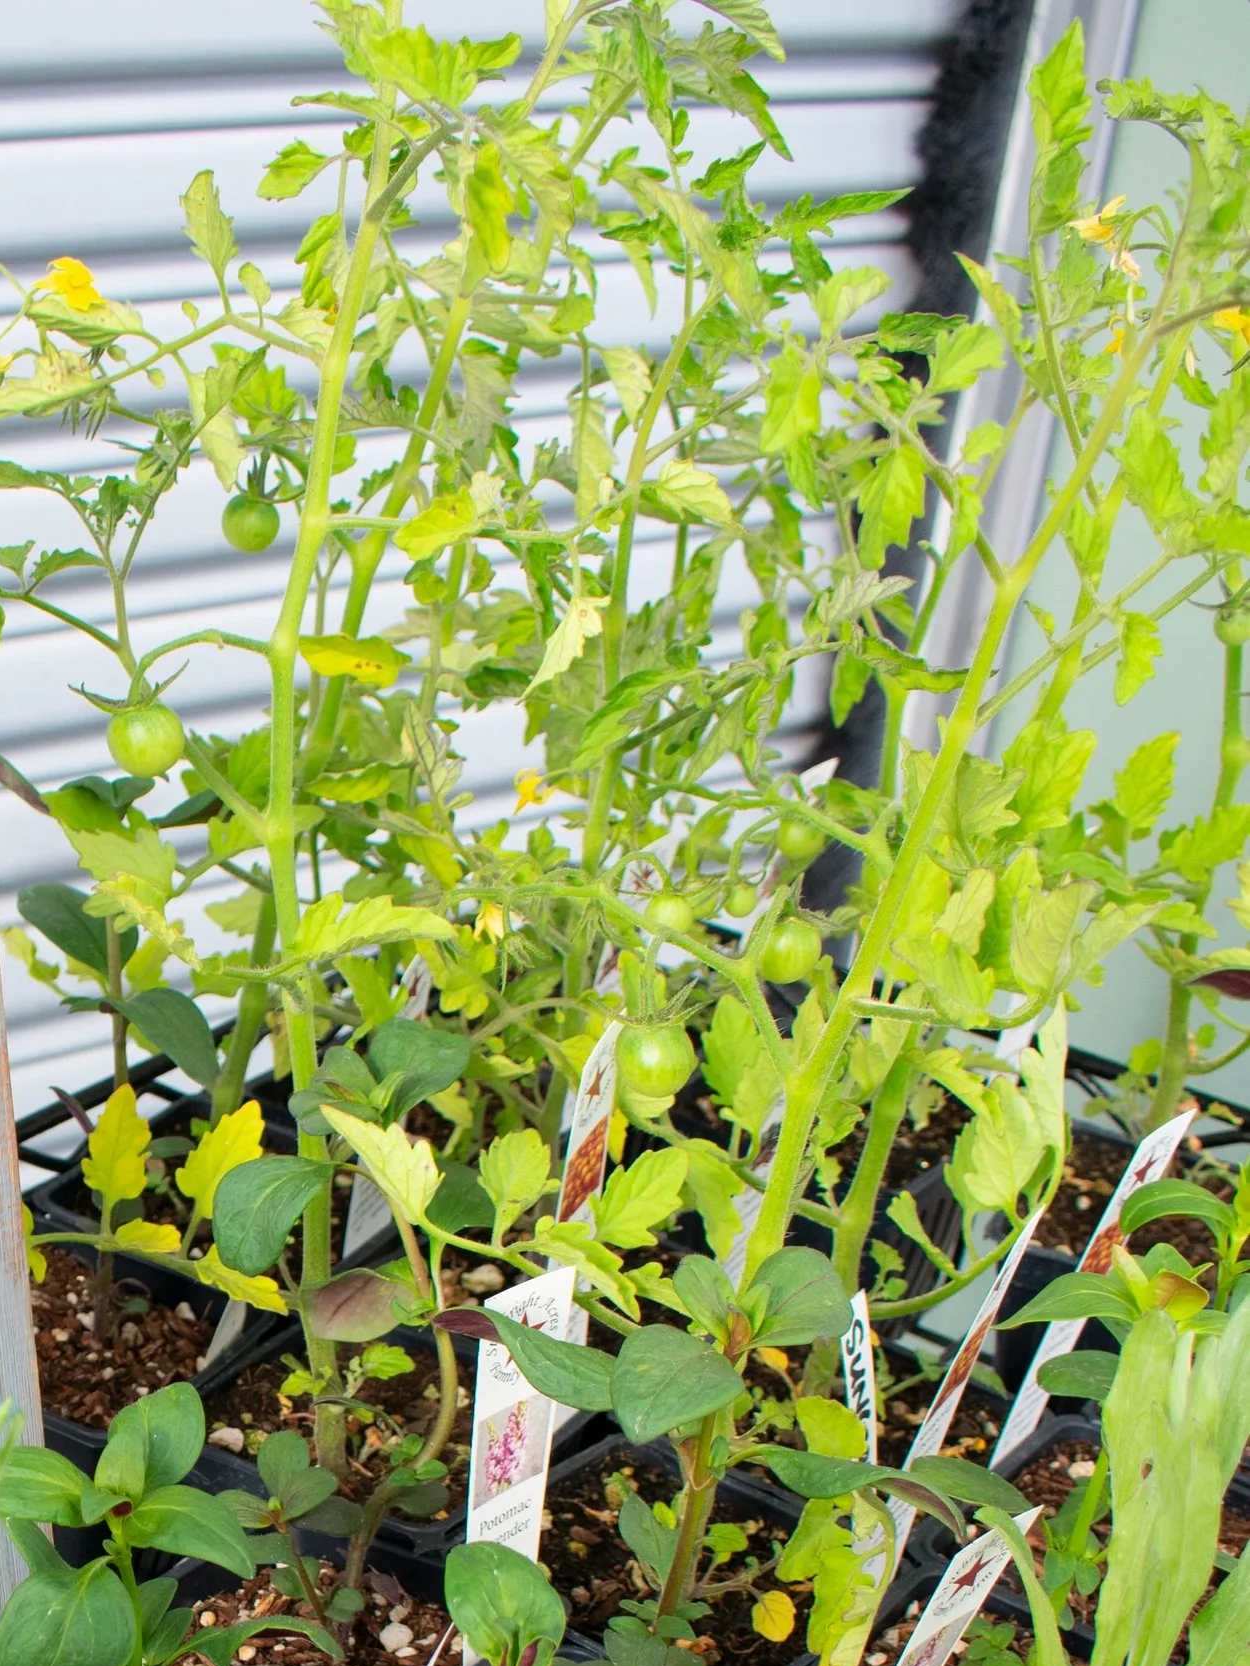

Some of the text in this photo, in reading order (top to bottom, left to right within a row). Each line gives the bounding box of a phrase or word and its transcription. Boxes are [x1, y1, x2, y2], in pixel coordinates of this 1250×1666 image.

[538, 1297, 559, 1331] Acres
[479, 1498, 532, 1536] Potomac
[494, 1518, 531, 1545] ender
